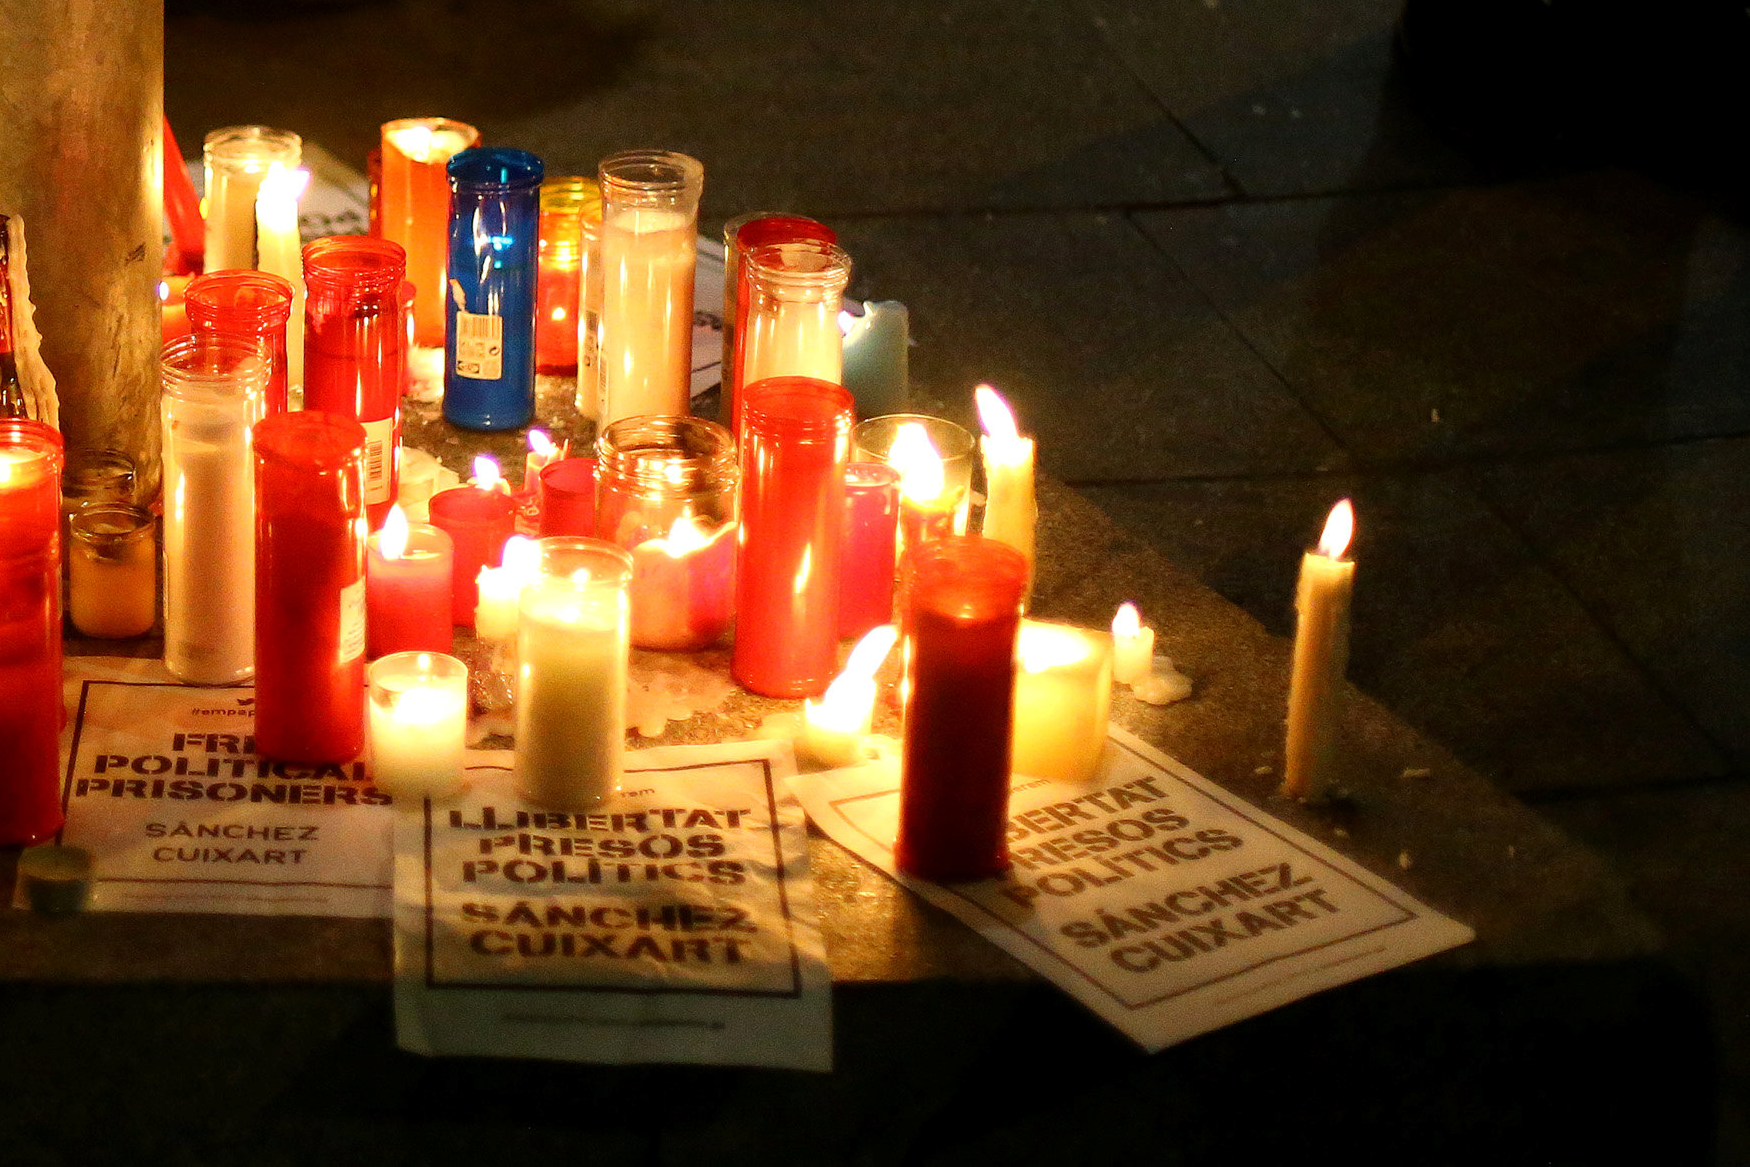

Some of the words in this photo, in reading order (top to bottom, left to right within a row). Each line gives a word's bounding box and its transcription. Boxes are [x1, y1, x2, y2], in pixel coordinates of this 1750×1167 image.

[172, 733, 256, 754] FR
[75, 779, 393, 805] PRISONERS
[449, 806, 752, 833] LLIBERTAT
[479, 833, 726, 859] PRESOS
[1007, 808, 1189, 870] RESOS
[153, 847, 308, 865] CUIXART
[1110, 888, 1340, 973] CUIXART
[469, 929, 751, 964] CUIXART
